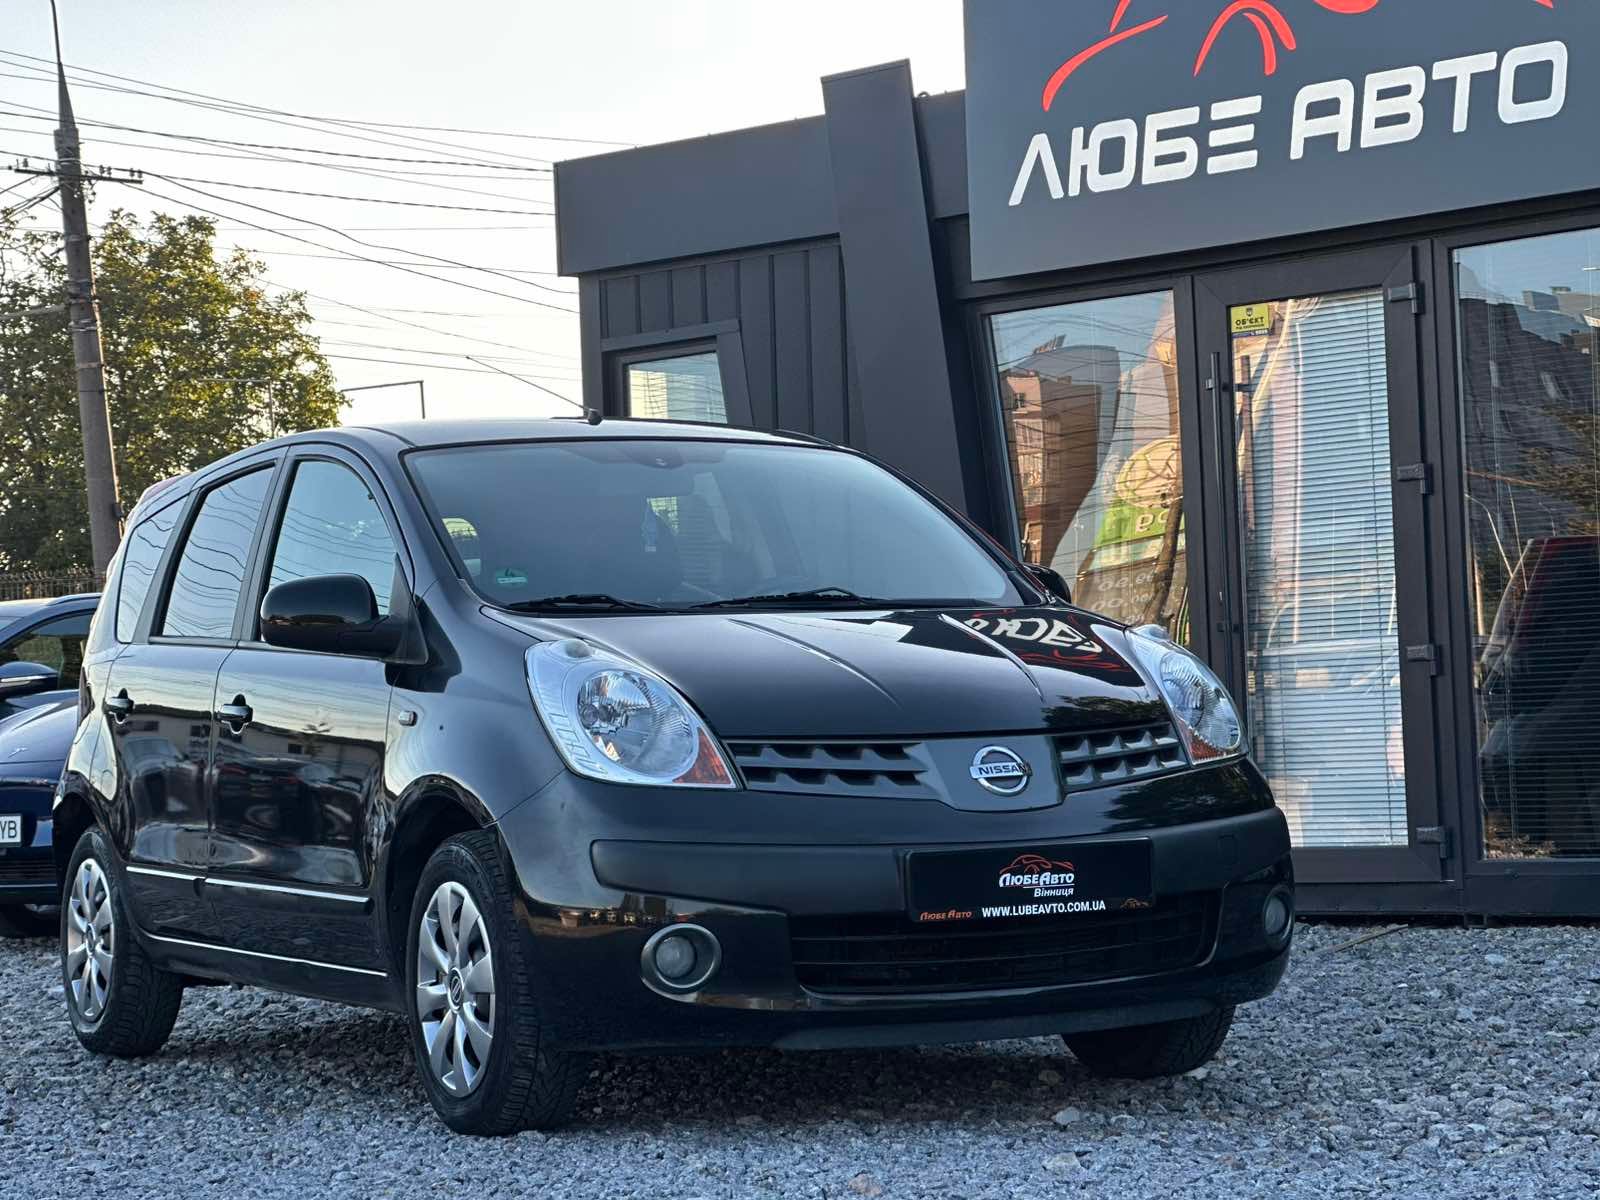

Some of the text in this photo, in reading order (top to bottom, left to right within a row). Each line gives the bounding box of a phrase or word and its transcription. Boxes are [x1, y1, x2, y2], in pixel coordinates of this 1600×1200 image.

[1008, 40, 1568, 206] ЛЮБЕ АВТО
[1033, 888, 1075, 898] Вінниця
[982, 900, 1106, 917] WWW.LUBEAVTO.COM.UA
